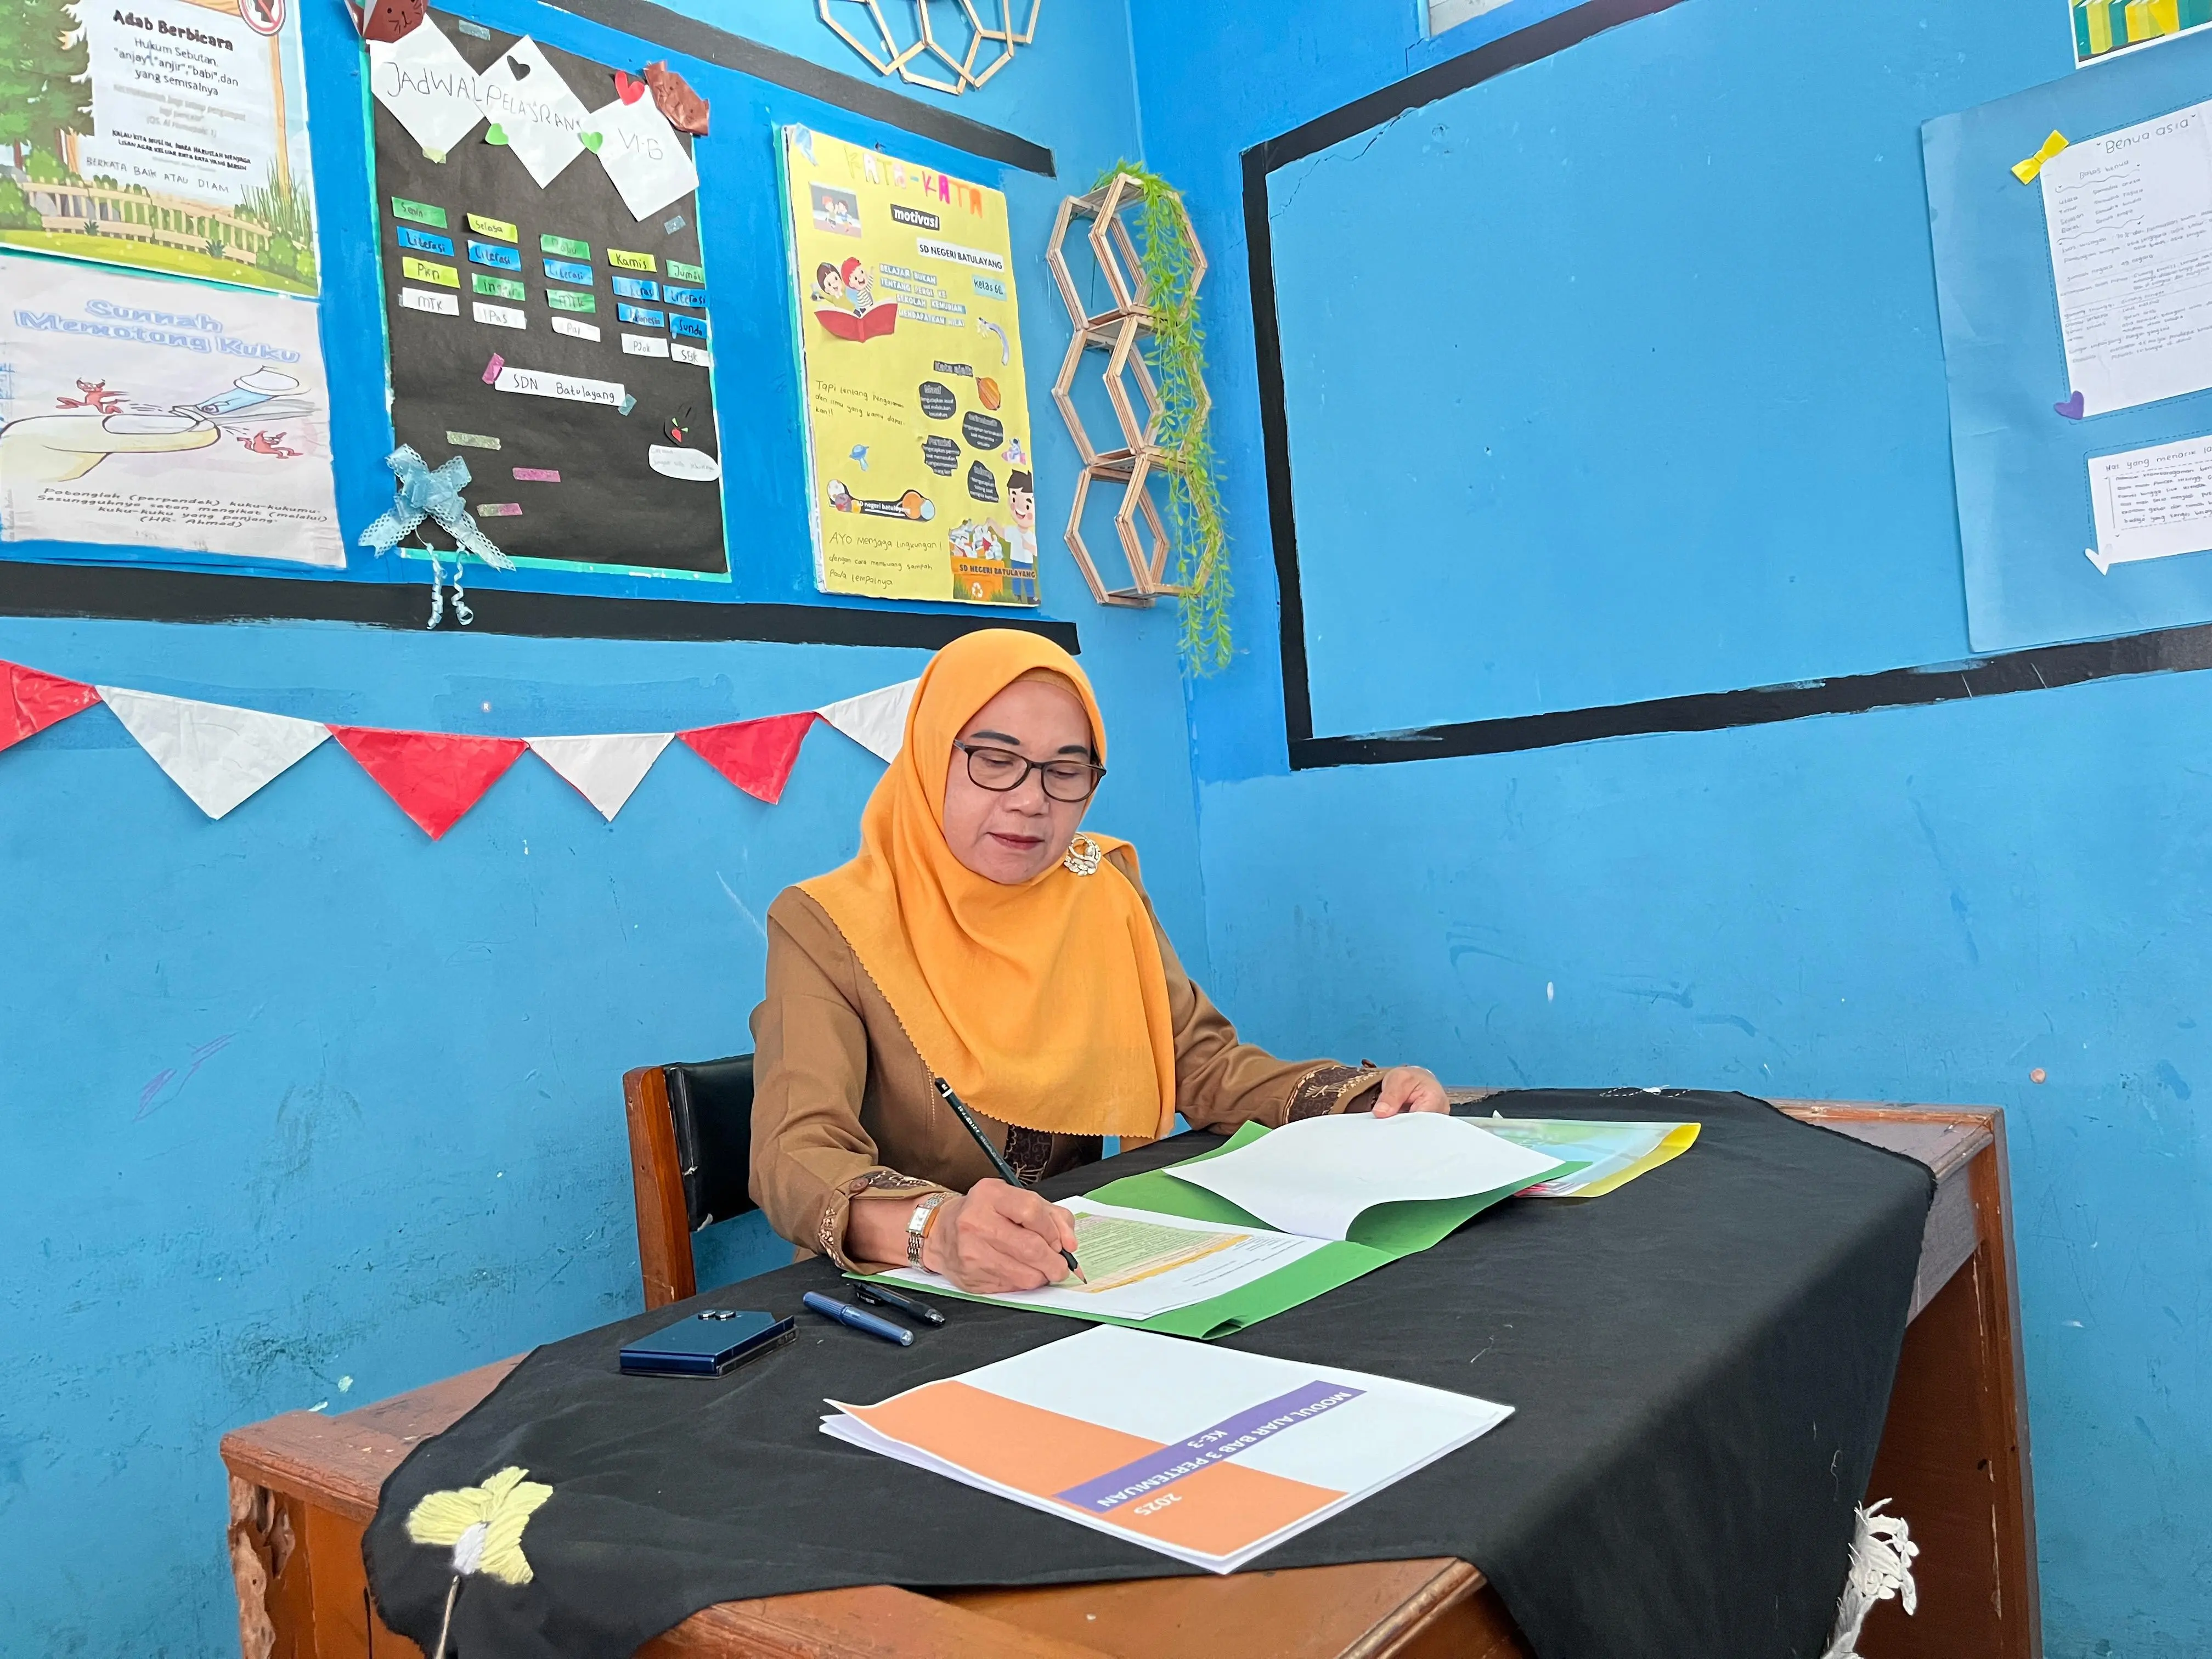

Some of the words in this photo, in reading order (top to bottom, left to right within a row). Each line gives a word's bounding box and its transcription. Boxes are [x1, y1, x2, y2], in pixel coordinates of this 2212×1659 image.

[113, 10, 153, 30] Adab
[158, 20, 233, 51] Berbicara
[134, 38, 172, 54] Hukum
[135, 69, 161, 83] yang
[163, 76, 218, 96] semisalnya
[2106, 132, 2149, 154] Benua
[2155, 119, 2188, 136] asia
[87, 156, 127, 172] BERKATA
[164, 173, 188, 184] ATAU
[198, 178, 229, 193] DIAM
[401, 202, 424, 218] Senin
[893, 208, 939, 228] motivasi
[407, 231, 445, 253] Literasi
[475, 247, 511, 264] Literasi
[616, 253, 647, 269] Kamis
[919, 244, 929, 253] SD
[931, 246, 956, 259] NEGERI
[957, 252, 1002, 269] BATULAYANG
[879, 264, 911, 278] BELAJAR
[913, 272, 936, 285] BUKAN
[881, 278, 911, 292] TENTANG
[896, 294, 926, 307] SEKOLAH
[85, 299, 222, 333] Sunnah
[14, 309, 211, 353] Memotong
[216, 336, 301, 363] Kuku
[679, 319, 703, 336] Sunda
[514, 374, 538, 391] SDN
[815, 393, 827, 403] dan
[847, 405, 863, 417] yang
[2127, 459, 2149, 469] yang
[44, 488, 121, 499] Potonglah
[129, 494, 220, 506] (perpendek)
[37, 495, 141, 507] Sesungguhnya
[269, 512, 328, 522] (melalui)
[98, 506, 173, 516] kuku-kuku
[185, 519, 242, 528] Ahmad)
[829, 532, 852, 546] AYO
[829, 554, 851, 565] dengan
[870, 561, 902, 571] membuang
[970, 565, 992, 574] NEGERI
[994, 567, 1035, 578] BATULAYANG
[1296, 1391, 1352, 1419] MODUL
[1250, 1414, 1294, 1437] AJAR
[1187, 1429, 1228, 1449] KE-3
[1218, 1434, 1257, 1453] BAB
[1206, 1451, 1223, 1460] 3
[1097, 1457, 1210, 1508] PERTEMUAN
[1133, 1492, 1183, 1516] 2025
